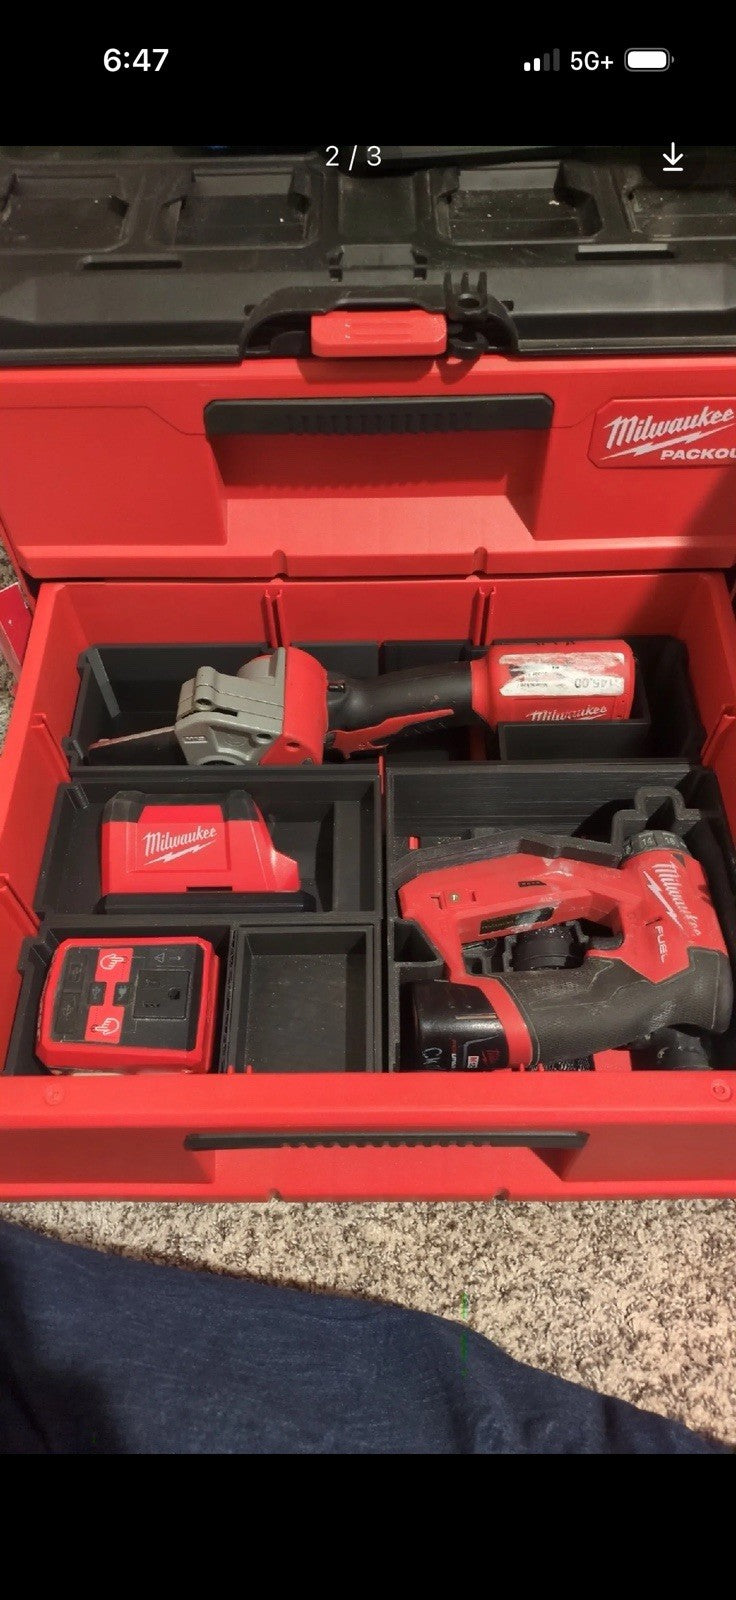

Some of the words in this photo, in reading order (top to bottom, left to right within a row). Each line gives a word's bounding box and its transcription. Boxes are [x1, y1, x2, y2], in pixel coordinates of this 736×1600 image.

[603, 405, 735, 450] Milwaukee
[525, 704, 608, 721] Milwaukee
[142, 825, 218, 857] Milwaukee
[652, 861, 701, 936] Milwaukee
[655, 925, 668, 963] FUEL
